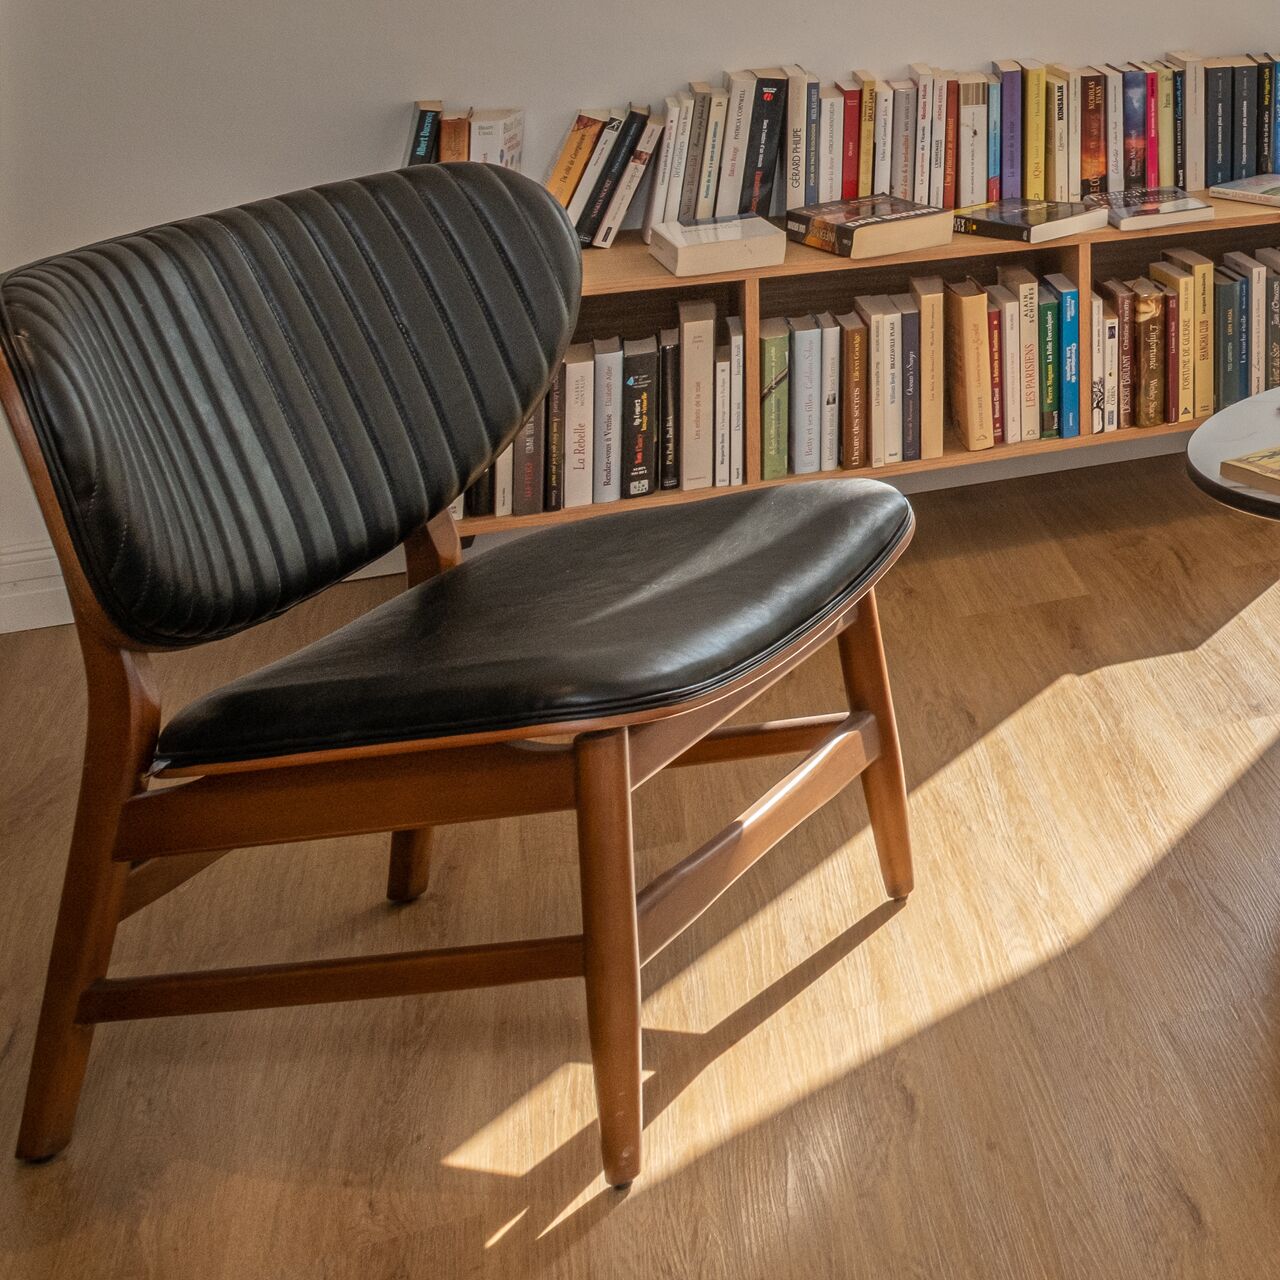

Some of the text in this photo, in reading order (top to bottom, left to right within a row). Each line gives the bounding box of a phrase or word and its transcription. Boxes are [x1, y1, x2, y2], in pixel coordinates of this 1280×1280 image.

[789, 128, 802, 189] GÉRARD PHILIPE
[844, 216, 882, 228] DAN
[1046, 311, 1054, 341] Forcalquier
[1200, 320, 1208, 361] SHANGHAI CLUB
[1146, 324, 1159, 370] L'infortunée
[1182, 318, 1190, 390] FORTUNE DE GUERRE
[906, 351, 916, 396] Ocean's Songs
[1025, 343, 1036, 407] LES PARISIENS
[804, 394, 813, 412] filles
[1147, 379, 1158, 417] Wesley Stace
[604, 414, 612, 436] Venise
[806, 427, 813, 435] et
[851, 388, 860, 465] L'heure des secrets
[573, 423, 585, 470] La Rebelle
[603, 444, 611, 486] Rendez-vous
[804, 438, 814, 456] Betty
